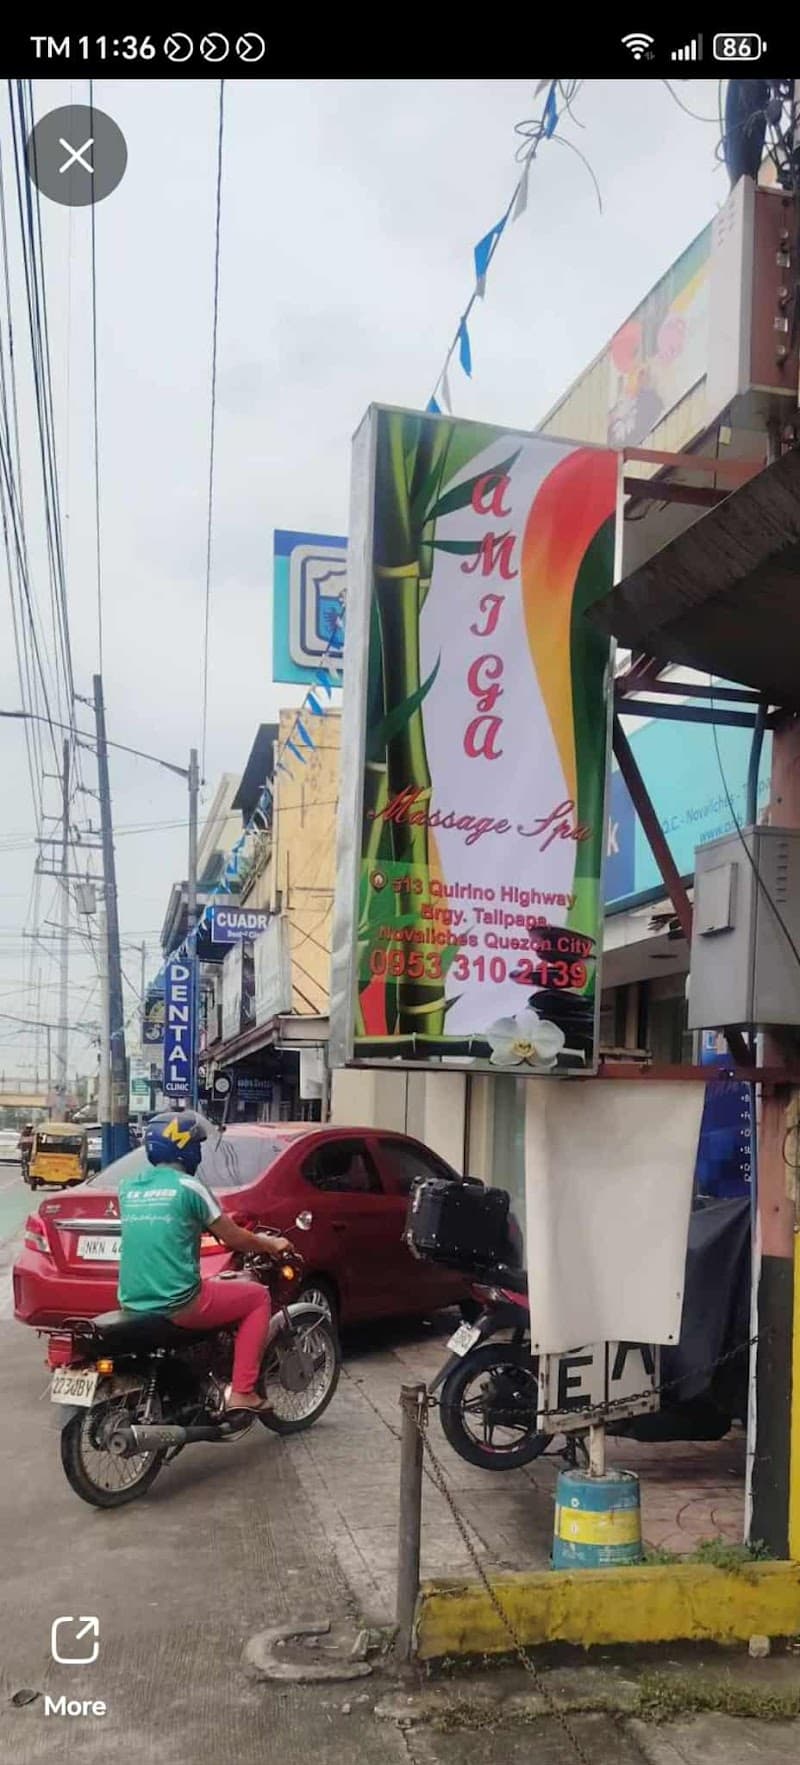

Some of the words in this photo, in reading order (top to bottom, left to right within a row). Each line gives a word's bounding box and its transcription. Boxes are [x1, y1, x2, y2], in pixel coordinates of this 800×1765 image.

[367, 784, 512, 846] Massage
[517, 799, 593, 852] Spa
[428, 880, 495, 901] Quirino
[500, 886, 577, 911] Highway
[420, 904, 467, 926] Brgy.
[484, 931, 552, 953] Quezon
[557, 937, 593, 957] City
[370, 947, 442, 979] 0953
[453, 954, 507, 984] 310
[516, 958, 588, 989] 2139
[168, 964, 190, 1082] DENTAL
[166, 1082, 189, 1092] CLINIC
